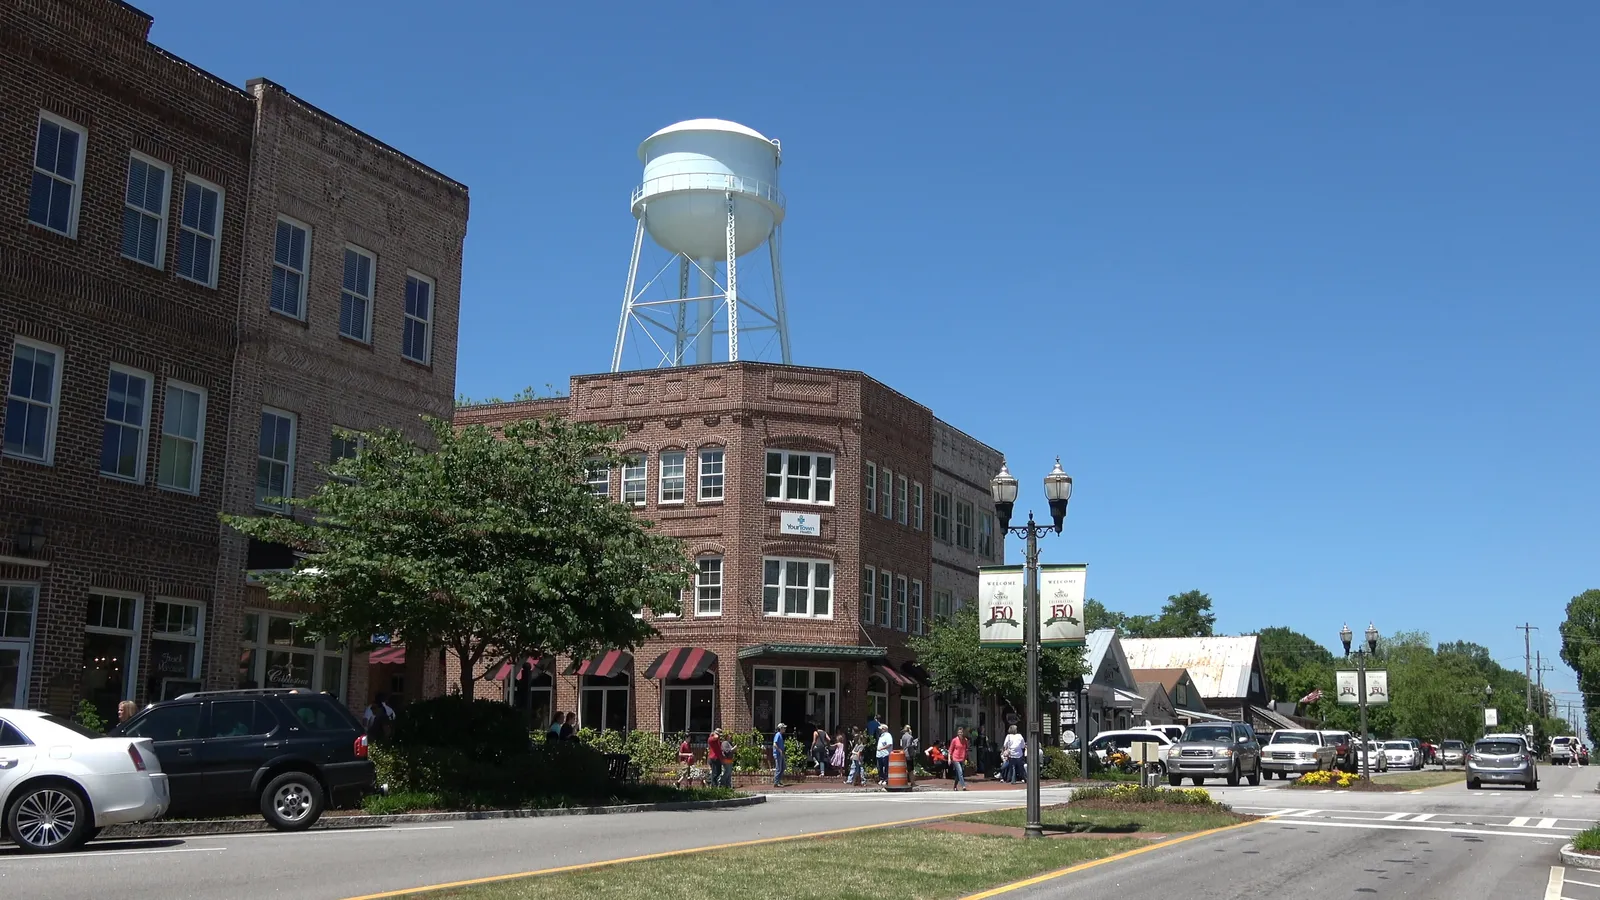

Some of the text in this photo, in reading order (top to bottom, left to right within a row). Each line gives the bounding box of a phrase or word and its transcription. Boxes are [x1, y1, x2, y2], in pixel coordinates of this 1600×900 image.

[786, 523, 815, 531] YourTown
[989, 605, 1013, 621] 150
[1050, 604, 1074, 619] 150
[1342, 686, 1354, 694] 150
[1371, 686, 1383, 694] 150
